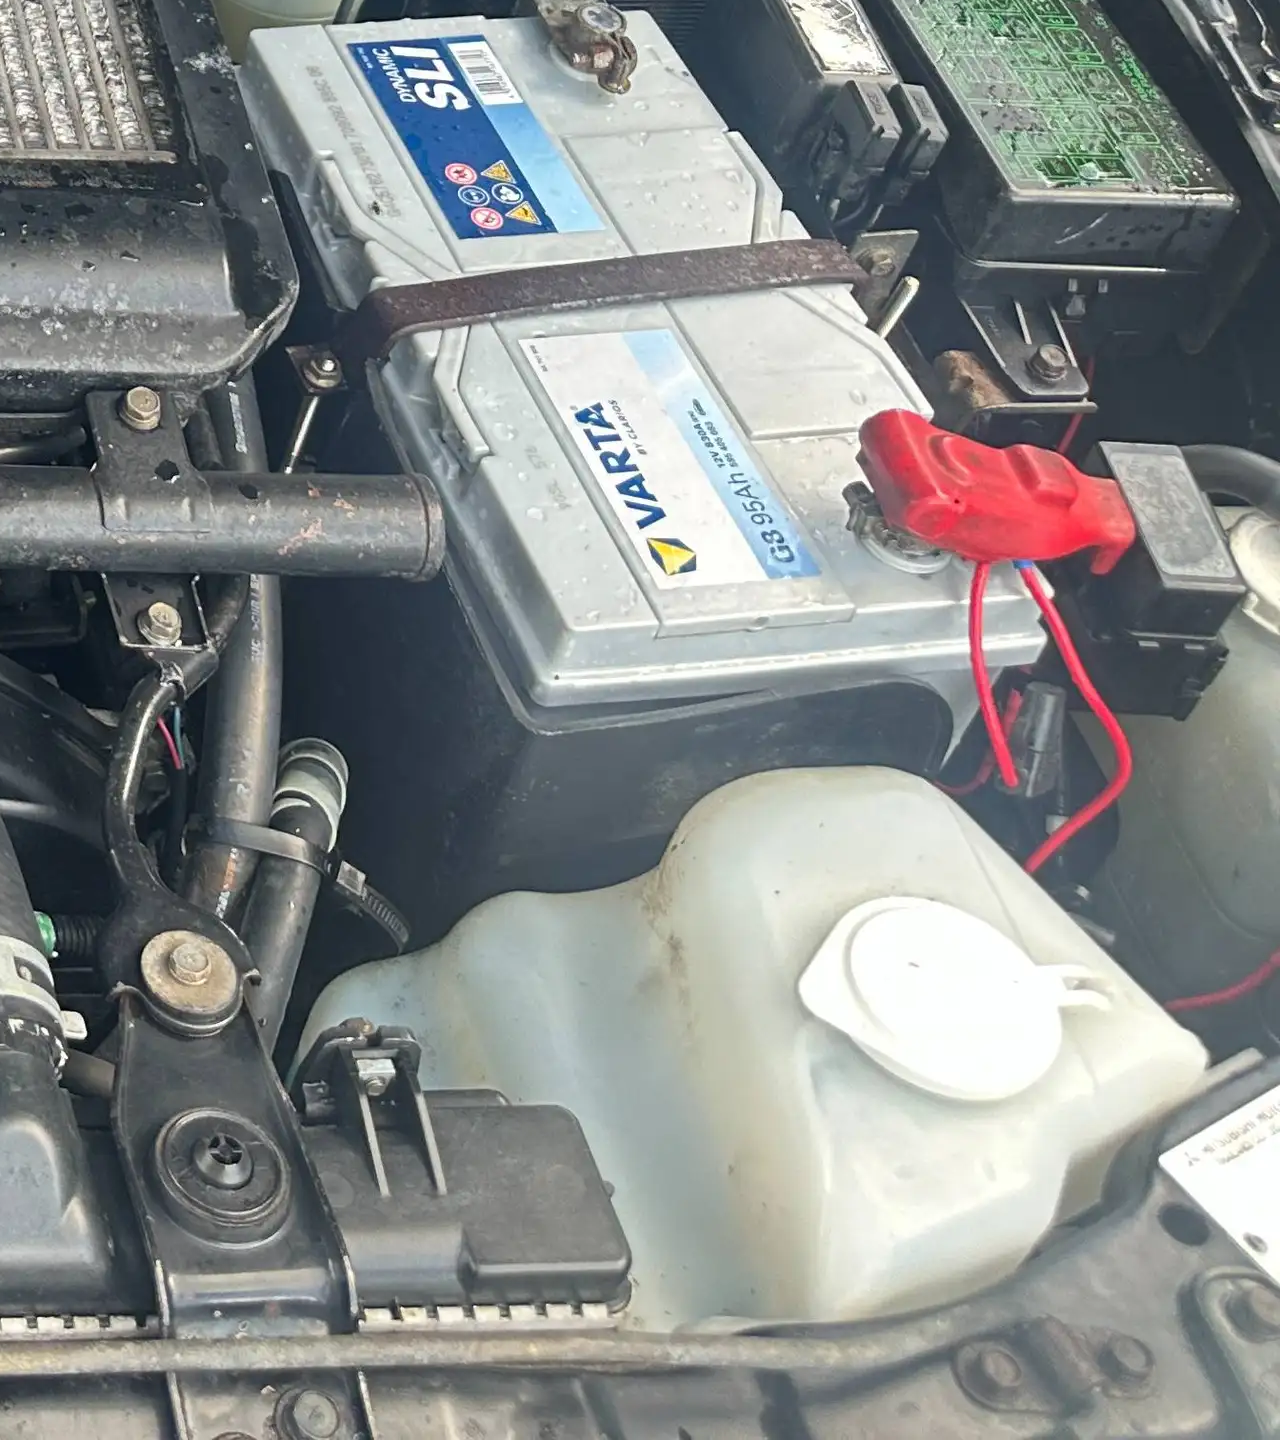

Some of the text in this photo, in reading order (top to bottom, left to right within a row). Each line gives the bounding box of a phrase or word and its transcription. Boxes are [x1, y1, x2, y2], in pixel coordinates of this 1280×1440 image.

[371, 46, 417, 104] DYNAMIC
[389, 45, 473, 111] SLI
[607, 398, 648, 456] BY CLARIOS
[573, 401, 667, 530] VARTA
[708, 448, 727, 469] 12V
[728, 471, 796, 564] G8 95Ah
